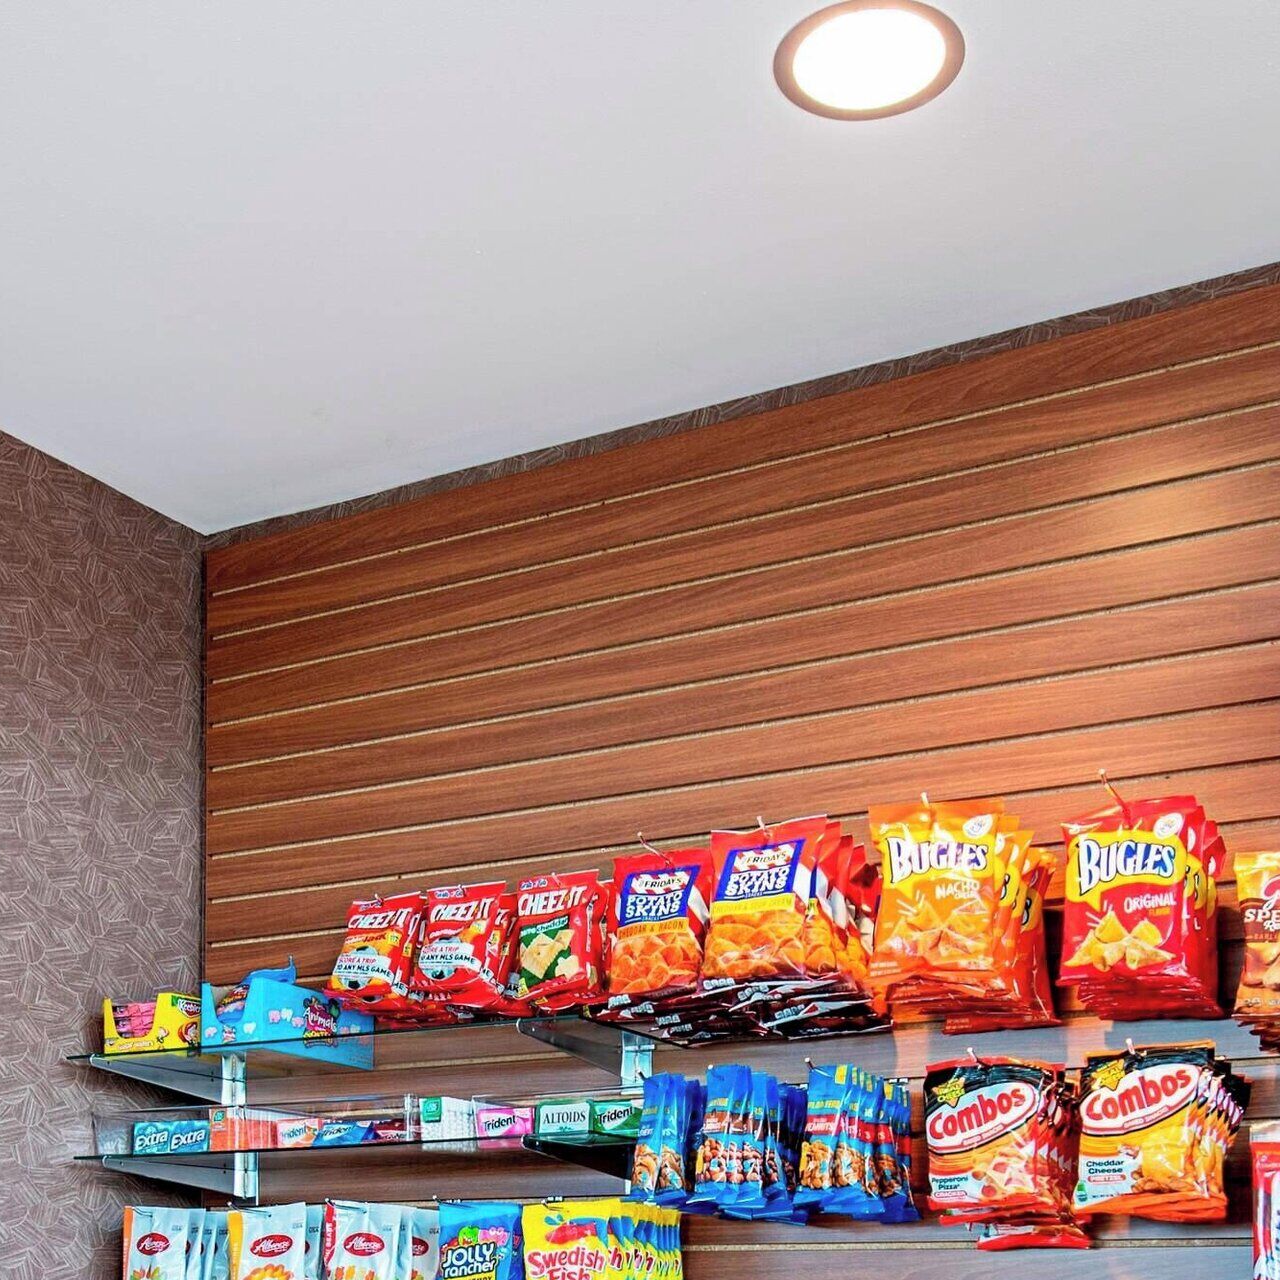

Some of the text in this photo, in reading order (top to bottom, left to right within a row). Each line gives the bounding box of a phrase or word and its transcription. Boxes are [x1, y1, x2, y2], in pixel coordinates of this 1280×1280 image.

[746, 851, 787, 863] FRIDAYS
[885, 836, 989, 884] BUGLES
[1079, 838, 1176, 895] BUGLES
[643, 878, 682, 888] FRIDAYS
[729, 866, 791, 882] POTATO
[724, 877, 787, 896] SKINS
[935, 879, 980, 900] NACHO
[626, 890, 683, 906] POTATO
[1123, 893, 1177, 914] ORIGINAL
[625, 901, 680, 918] SKINS
[303, 1007, 338, 1033] Animals
[1085, 1069, 1192, 1121] Combos
[483, 1114, 516, 1132] Trident
[542, 1110, 586, 1124] ALTOIDS
[596, 1105, 633, 1124] Trident
[929, 1087, 1027, 1140] Combos
[135, 1129, 168, 1150] Extra
[170, 1129, 206, 1151] Extra
[1086, 1160, 1125, 1168] Cheddar
[931, 1176, 969, 1184] Pepperoni
[444, 1243, 495, 1267] JOLLY
[526, 1247, 606, 1275] Swedish
[444, 1259, 496, 1278] rancher
